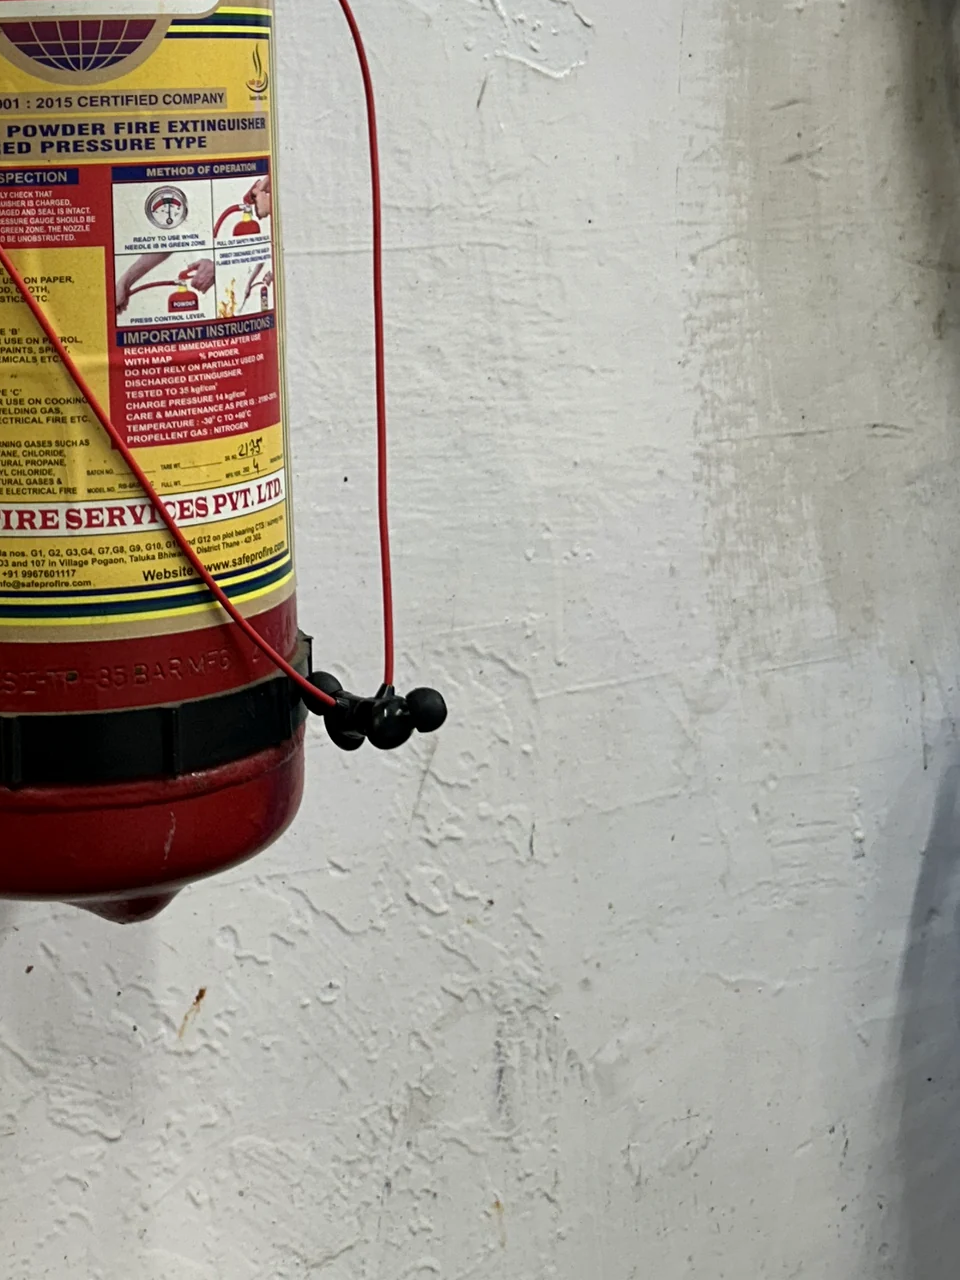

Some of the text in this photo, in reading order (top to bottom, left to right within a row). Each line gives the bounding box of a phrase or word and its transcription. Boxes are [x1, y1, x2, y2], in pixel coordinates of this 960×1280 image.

[36, 96, 72, 109] 2015
[77, 93, 159, 108] CERTIFIED
[162, 92, 225, 106] COMPANY
[7, 122, 105, 138] POWDER
[114, 121, 160, 135] FIRE
[168, 117, 266, 133] EXTINGUISHER
[40, 138, 155, 153] PRESSURE
[162, 136, 207, 150] TYPE
[146, 163, 257, 177] METHOD OF OPERATION
[9, 190, 53, 199] CHECK THAT
[21, 207, 36, 216] AND
[62, 224, 90, 232] NOZZLE
[154, 315, 185, 323] CONTROL
[123, 326, 203, 345] IMPORTANT
[124, 338, 230, 355] RECHARGE IMMEDIATELY
[124, 355, 173, 366] WITH MAP
[163, 358, 240, 374] RELY PARTIALLY
[125, 375, 187, 388] DISCHARGED
[44, 396, 88, 405] COOKING
[125, 388, 163, 399] TESTED
[125, 395, 214, 411] CHARGE PRESSURE
[126, 403, 224, 421] CARE MAINTENANCE
[46, 415, 68, 424] FIRE
[126, 419, 195, 433] TEMPERATURE
[126, 421, 249, 444] PROPELLENT NITROGEN
[24, 439, 53, 448] GASES
[54, 439, 78, 447] SUCH
[5, 487, 57, 495] ELECTRICAL
[212, 486, 255, 515] PVT.
[257, 477, 283, 504] LTD.
[235, 526, 255, 538] bearing
[59, 544, 220, 568] Village Taluka District
[142, 564, 194, 582] Website
